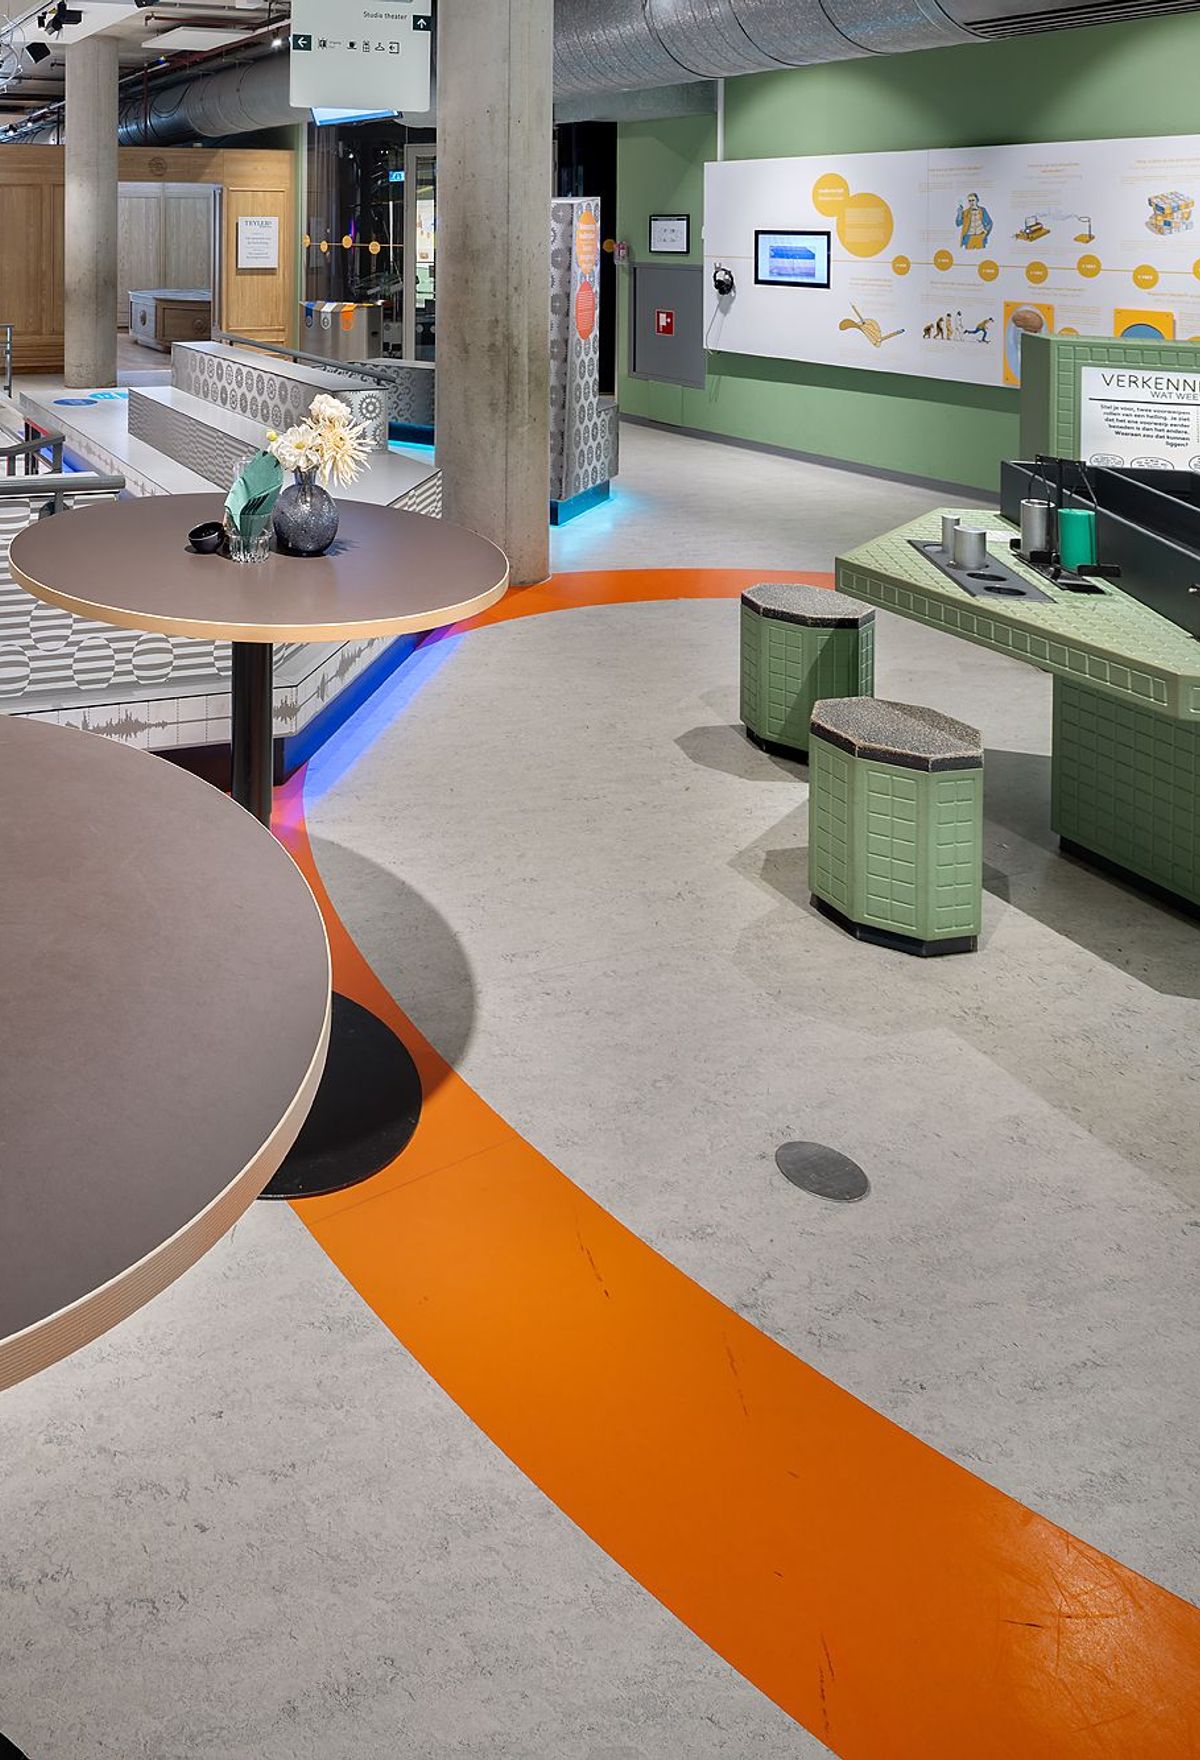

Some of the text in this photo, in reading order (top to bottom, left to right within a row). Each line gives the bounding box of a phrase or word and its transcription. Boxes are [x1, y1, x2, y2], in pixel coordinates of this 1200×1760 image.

[363, 10, 408, 20] Studio theater
[1150, 390, 1174, 400] WAT
